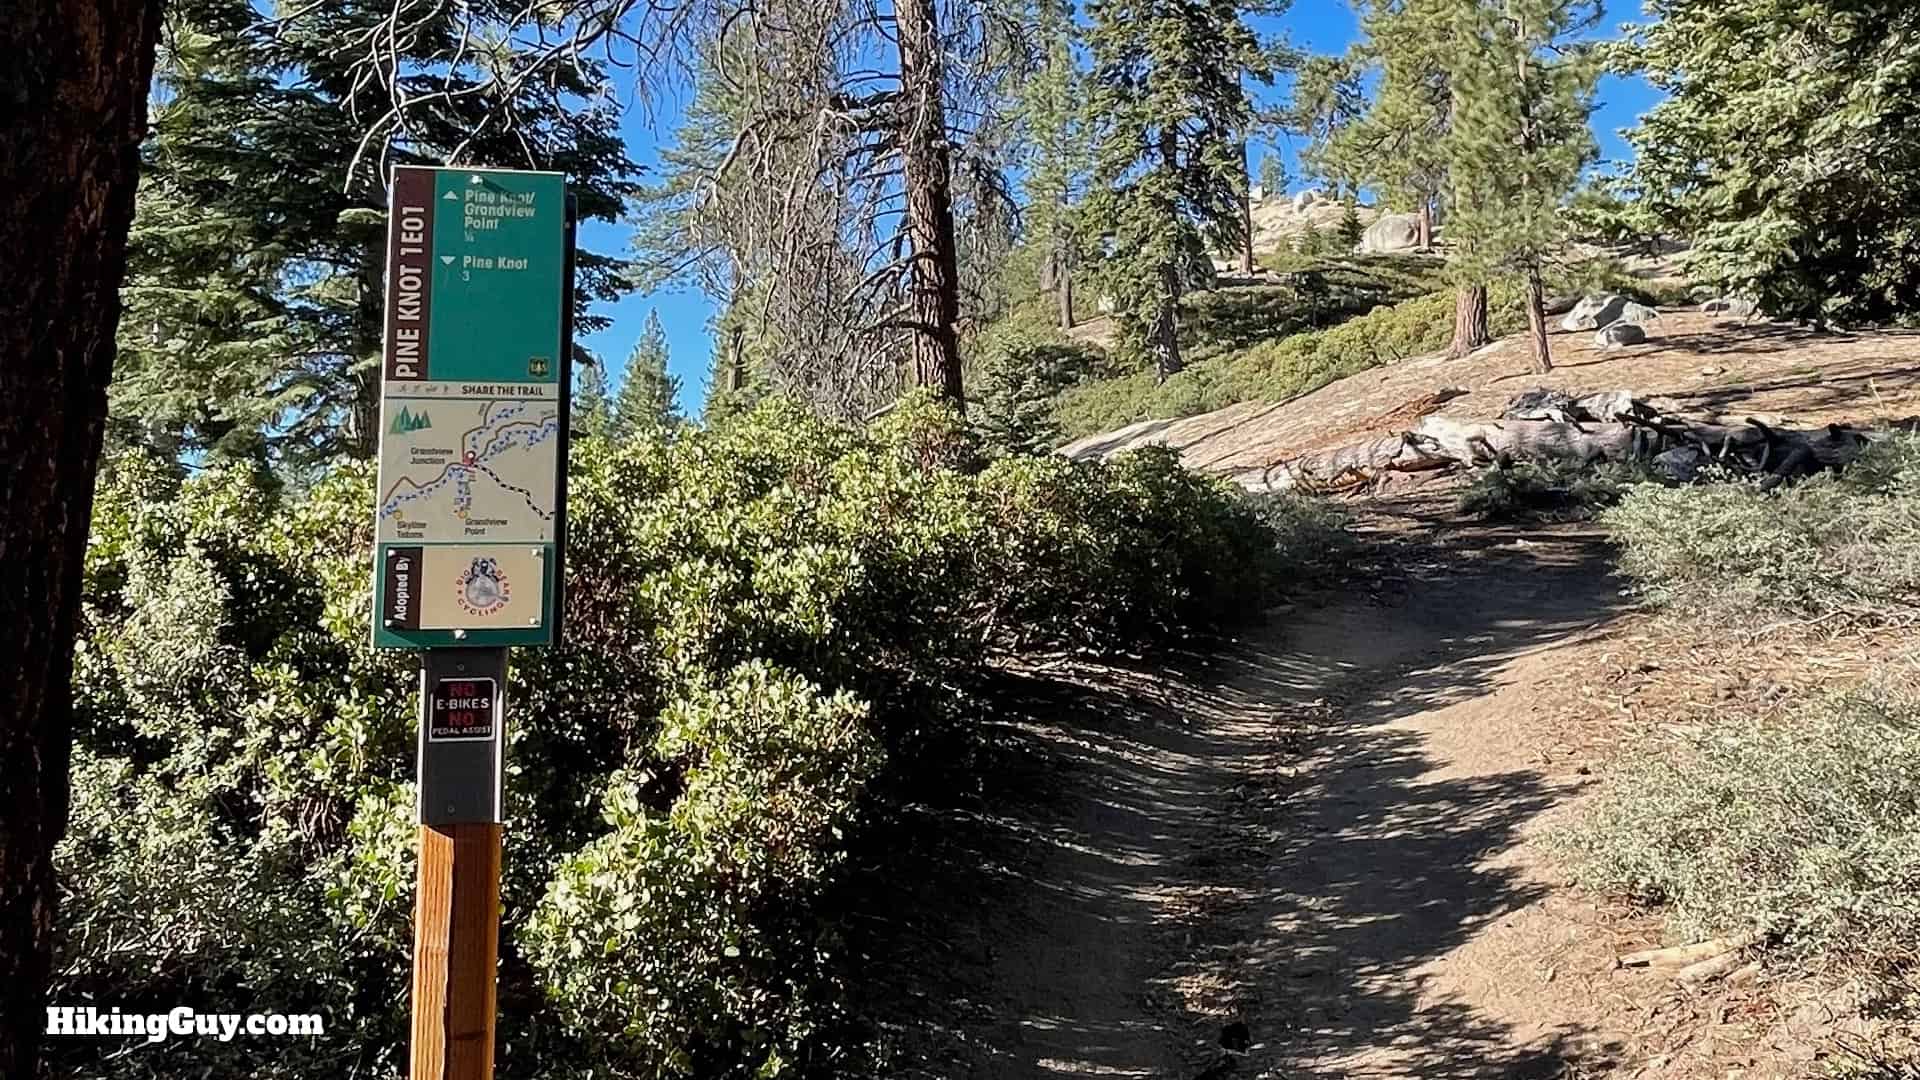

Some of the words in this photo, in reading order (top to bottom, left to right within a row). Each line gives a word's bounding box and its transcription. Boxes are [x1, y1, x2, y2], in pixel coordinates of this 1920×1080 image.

[464, 189, 495, 203] Pine
[464, 202, 535, 217] Grandview
[464, 216, 498, 230] Point
[400, 206, 425, 256] 1E01
[463, 255, 493, 269] Pine
[497, 256, 528, 270] Knot
[462, 270, 470, 281] 3
[397, 264, 422, 320] KNOT
[395, 328, 420, 377] PINE
[462, 385, 494, 396] SHARE
[497, 385, 515, 396] THE
[518, 386, 543, 396] TRAIL
[395, 556, 411, 571] By
[393, 573, 410, 621] Adopted
[436, 697, 490, 711] E-BIKES
[448, 711, 474, 726] NO
